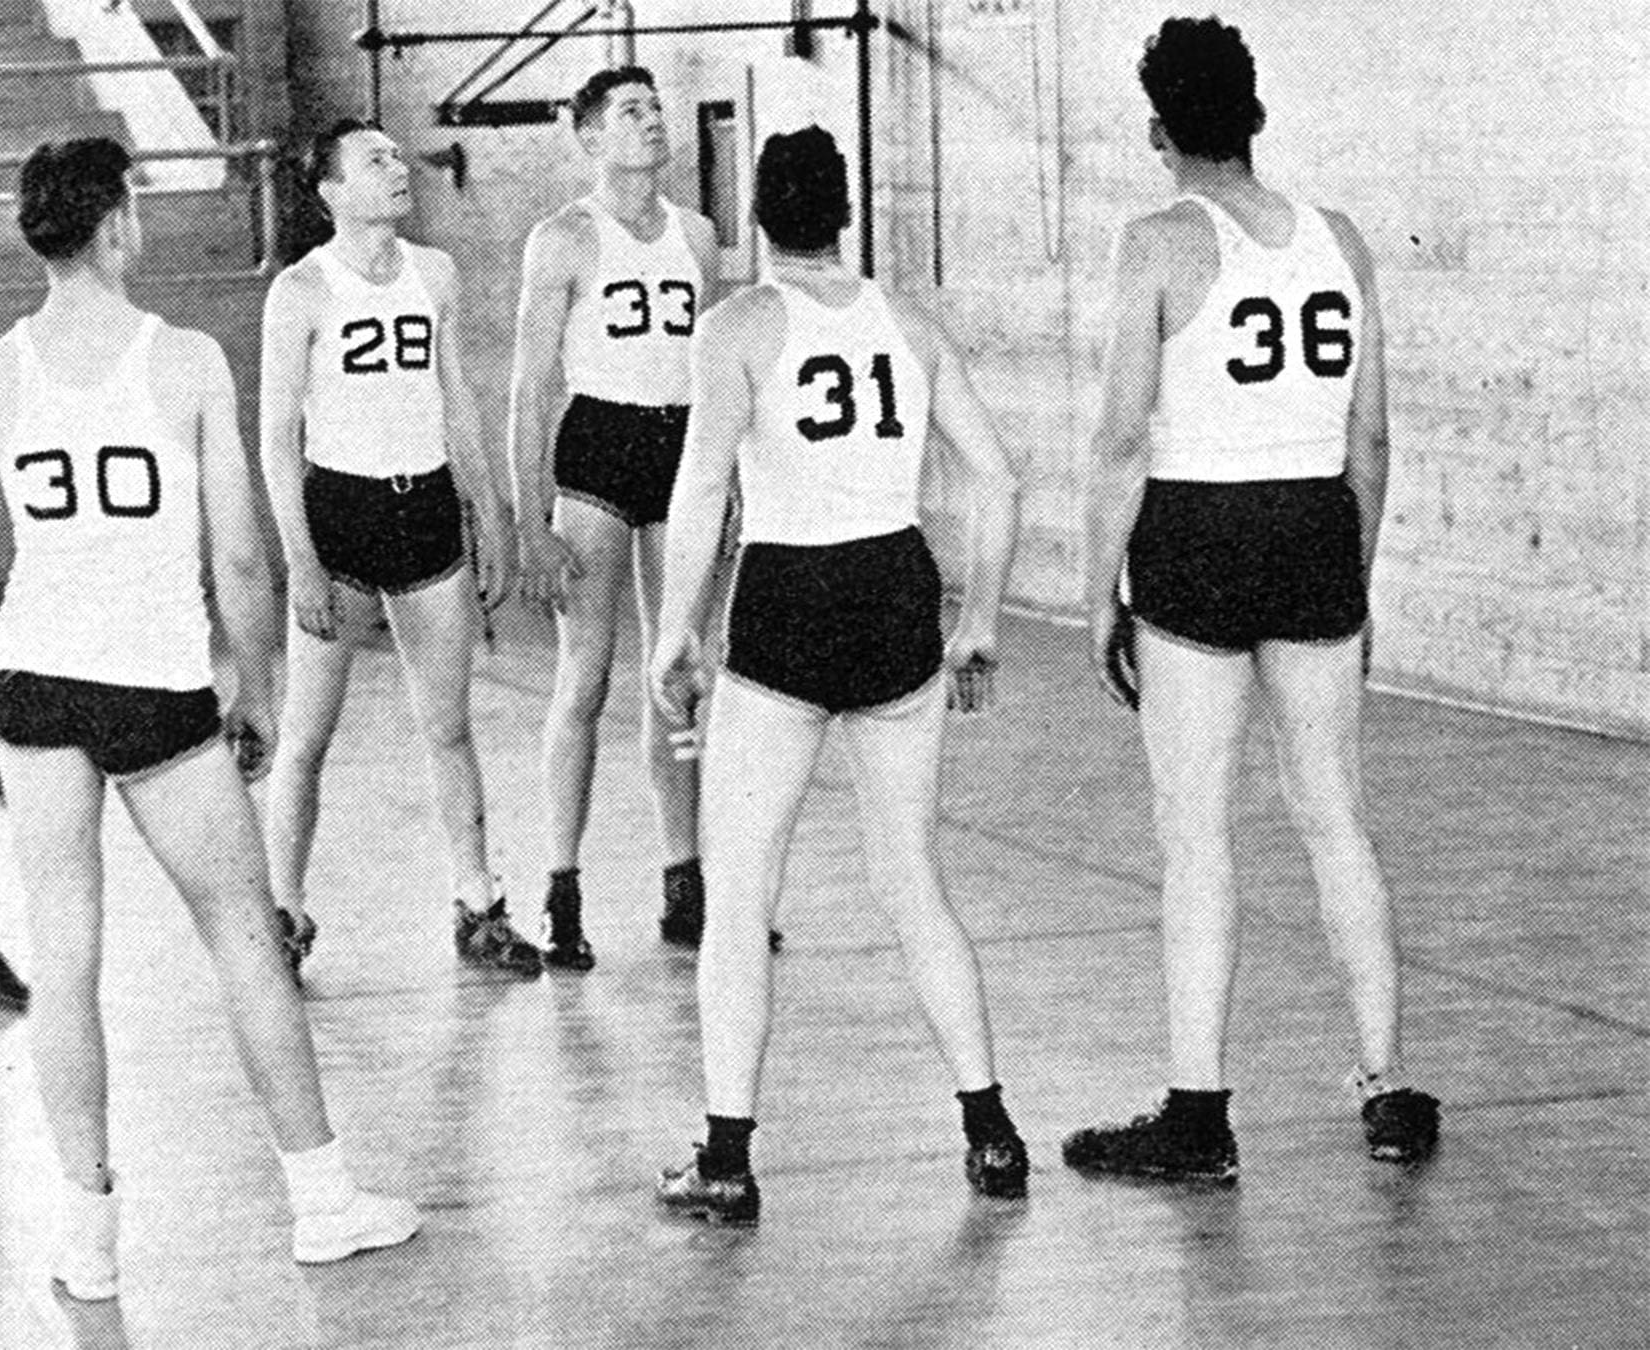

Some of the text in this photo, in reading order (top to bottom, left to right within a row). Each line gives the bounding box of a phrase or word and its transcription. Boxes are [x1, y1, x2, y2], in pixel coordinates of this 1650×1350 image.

[341, 314, 433, 374] 28
[603, 279, 695, 338] 33
[1227, 291, 1353, 384] 36
[796, 353, 904, 441] 31
[15, 446, 161, 520] 30
